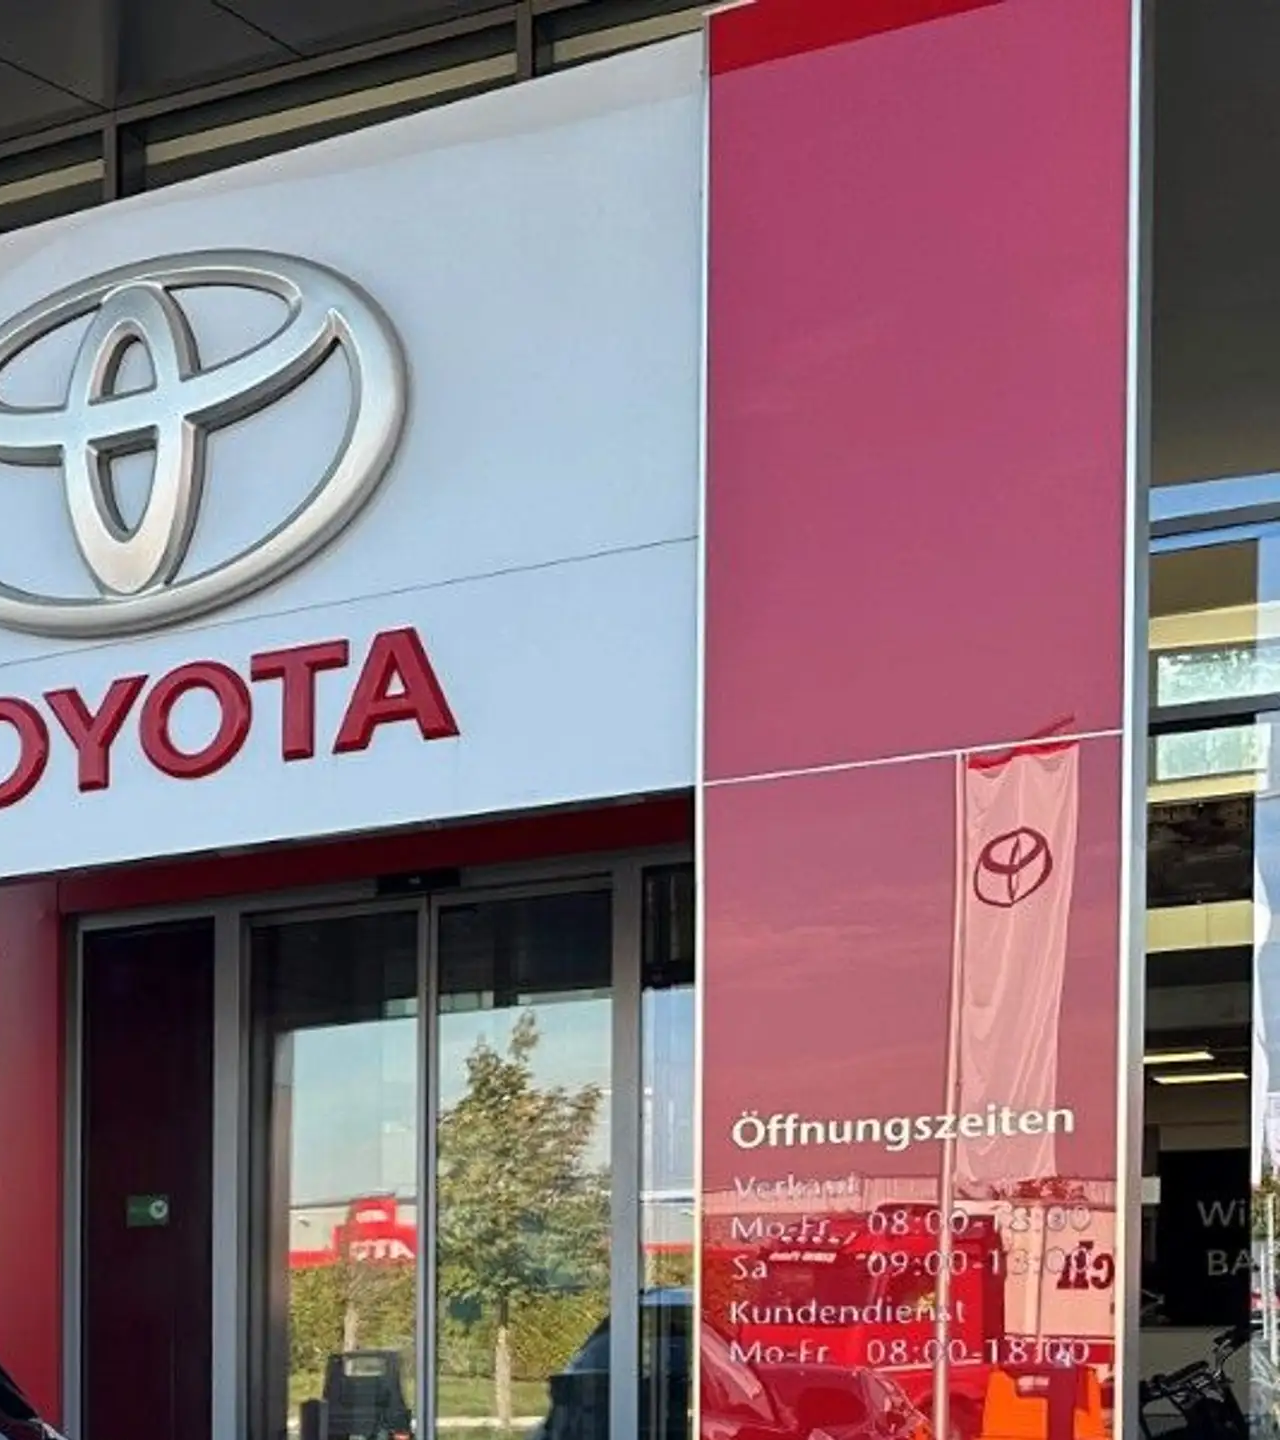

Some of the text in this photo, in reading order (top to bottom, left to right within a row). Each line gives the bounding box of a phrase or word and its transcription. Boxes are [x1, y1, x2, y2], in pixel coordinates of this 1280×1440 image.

[731, 1103, 1075, 1152] Öffnungszeiten
[730, 1212, 832, 1240] Mo-Fr
[730, 1254, 768, 1280] Sa
[729, 1300, 966, 1326] Kundendienst
[729, 1339, 1090, 1365] Mo-Fr 08:00-18:00
